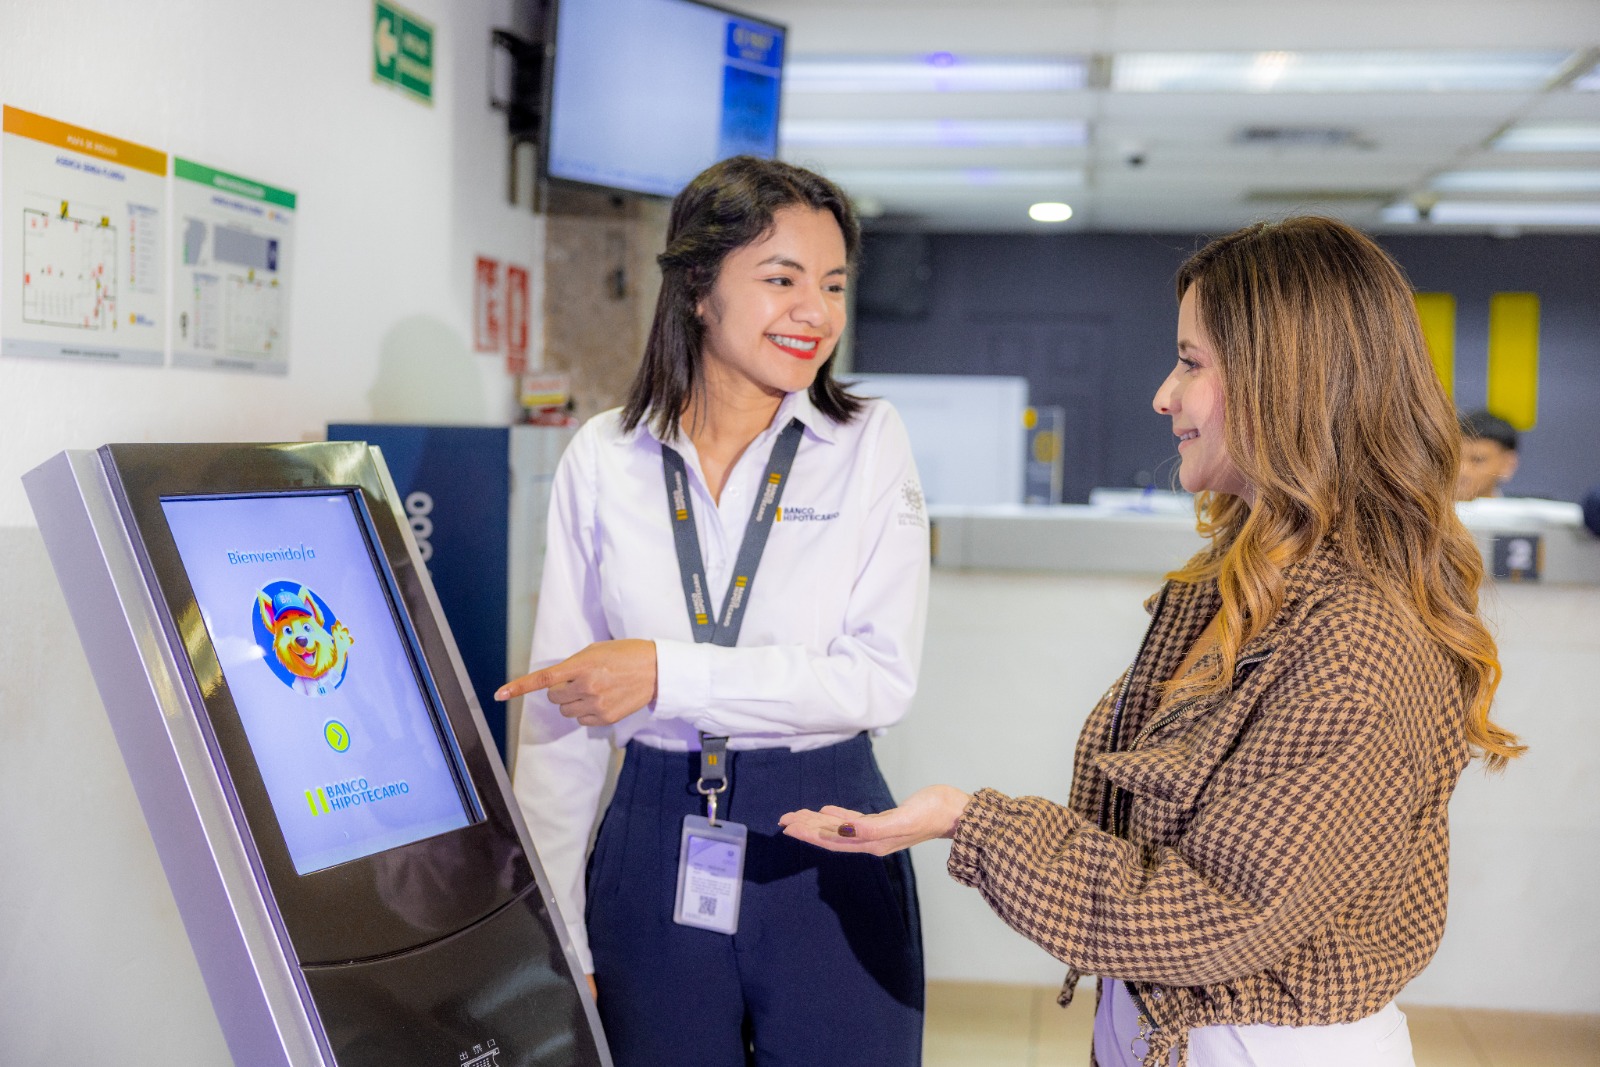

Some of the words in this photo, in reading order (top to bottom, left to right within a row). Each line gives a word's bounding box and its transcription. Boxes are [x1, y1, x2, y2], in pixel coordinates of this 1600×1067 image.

[784, 507, 815, 515] BANCO
[784, 512, 840, 522] HIPOTECARIO
[227, 543, 316, 565] Bienvenido/a
[1506, 539, 1532, 570] 2
[326, 778, 368, 799] BANCO
[330, 782, 409, 811] HIPOTECARIO
